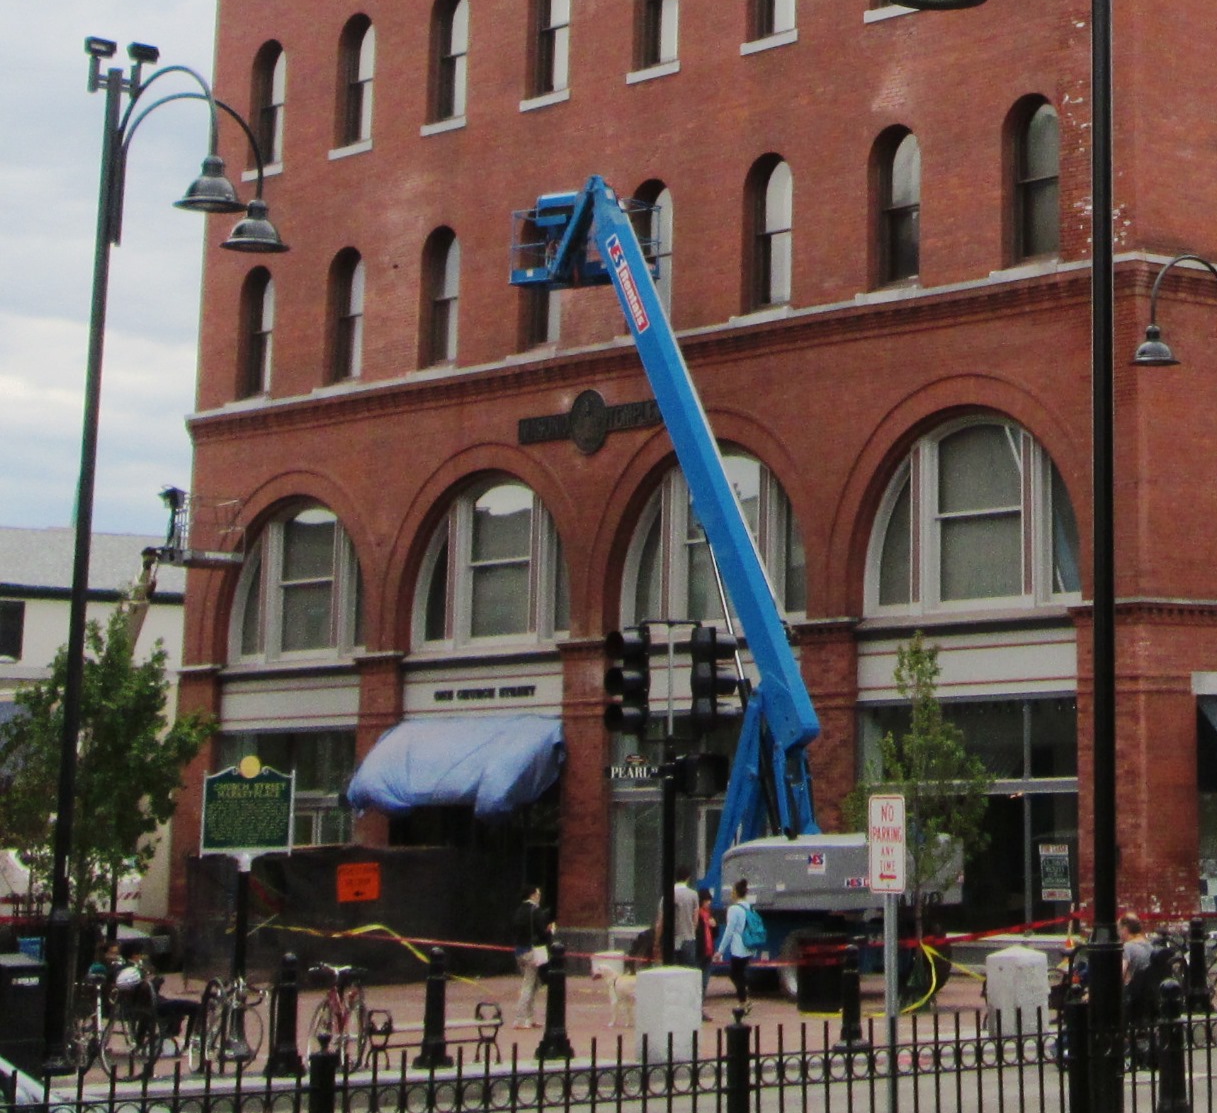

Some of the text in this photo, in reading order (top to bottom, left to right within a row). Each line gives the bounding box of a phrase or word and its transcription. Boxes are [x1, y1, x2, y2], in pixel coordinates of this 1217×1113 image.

[619, 268, 645, 326] Rentals
[456, 688, 496, 700] CHURCH
[499, 685, 536, 698] STREET
[611, 766, 650, 778] PEARL
[881, 805, 895, 822] NO
[872, 827, 903, 843] PARKING
[881, 847, 895, 856] ANY
[880, 860, 896, 872] TIME
